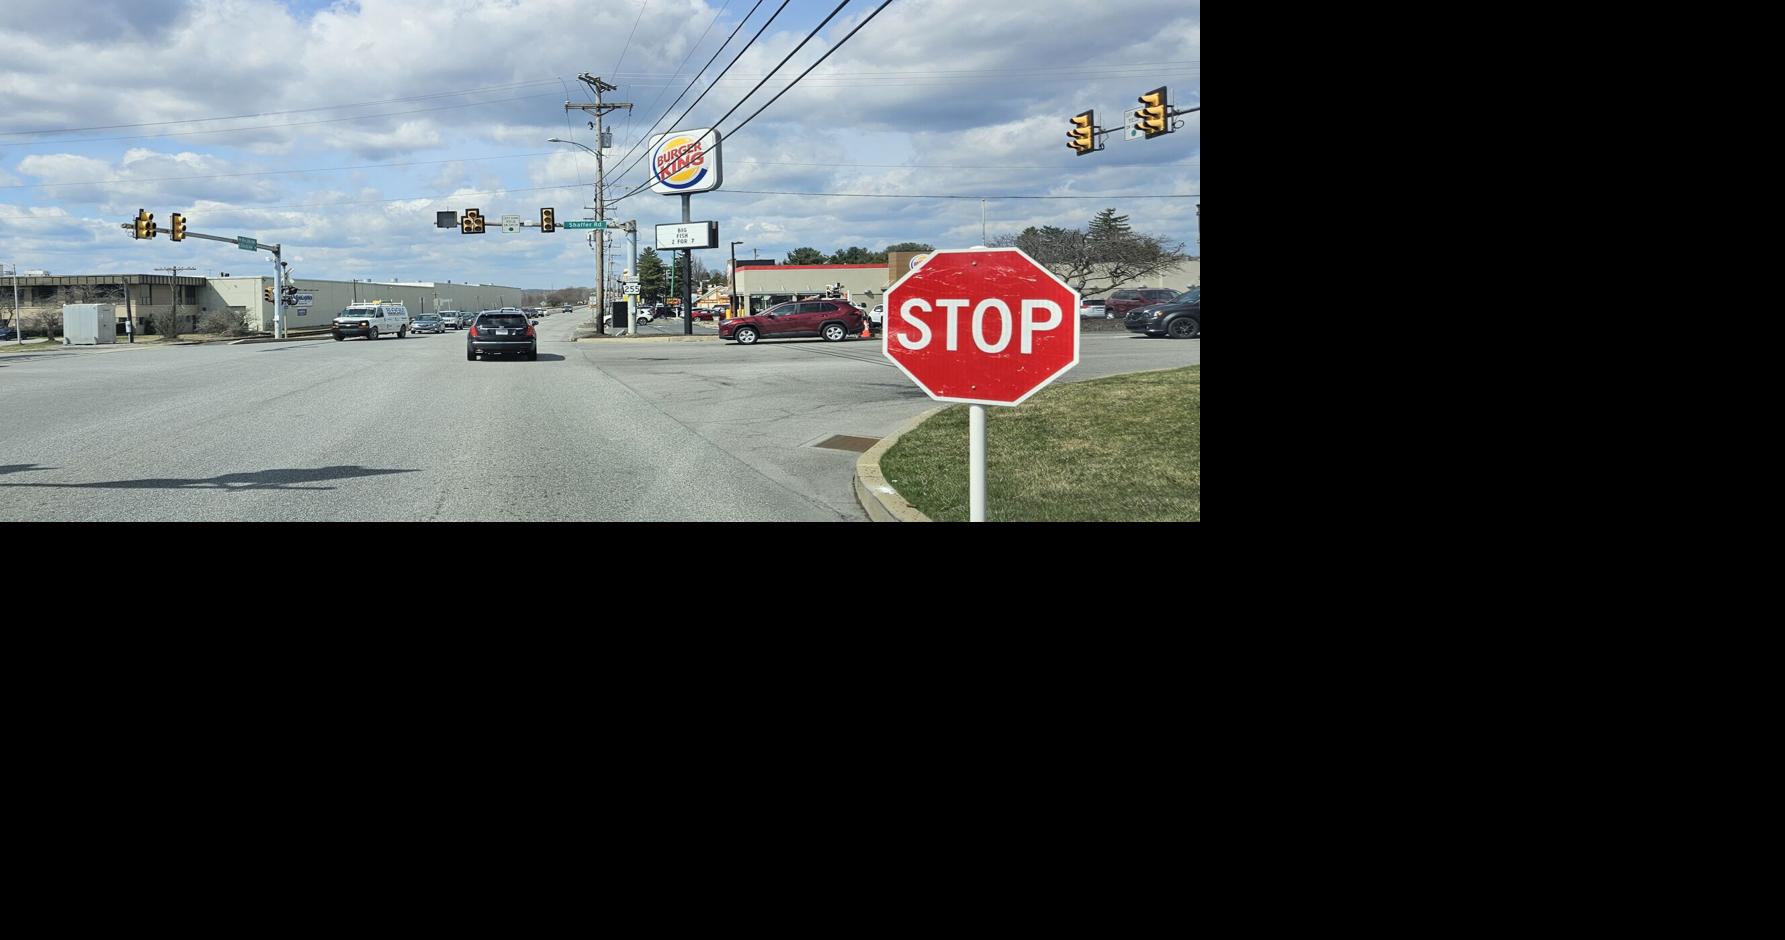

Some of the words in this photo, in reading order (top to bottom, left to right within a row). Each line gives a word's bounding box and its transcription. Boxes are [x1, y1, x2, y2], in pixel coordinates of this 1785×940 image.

[657, 142, 702, 167] BURGER
[660, 151, 704, 181] KING
[624, 285, 640, 293] 255
[897, 297, 1063, 355] STOP
